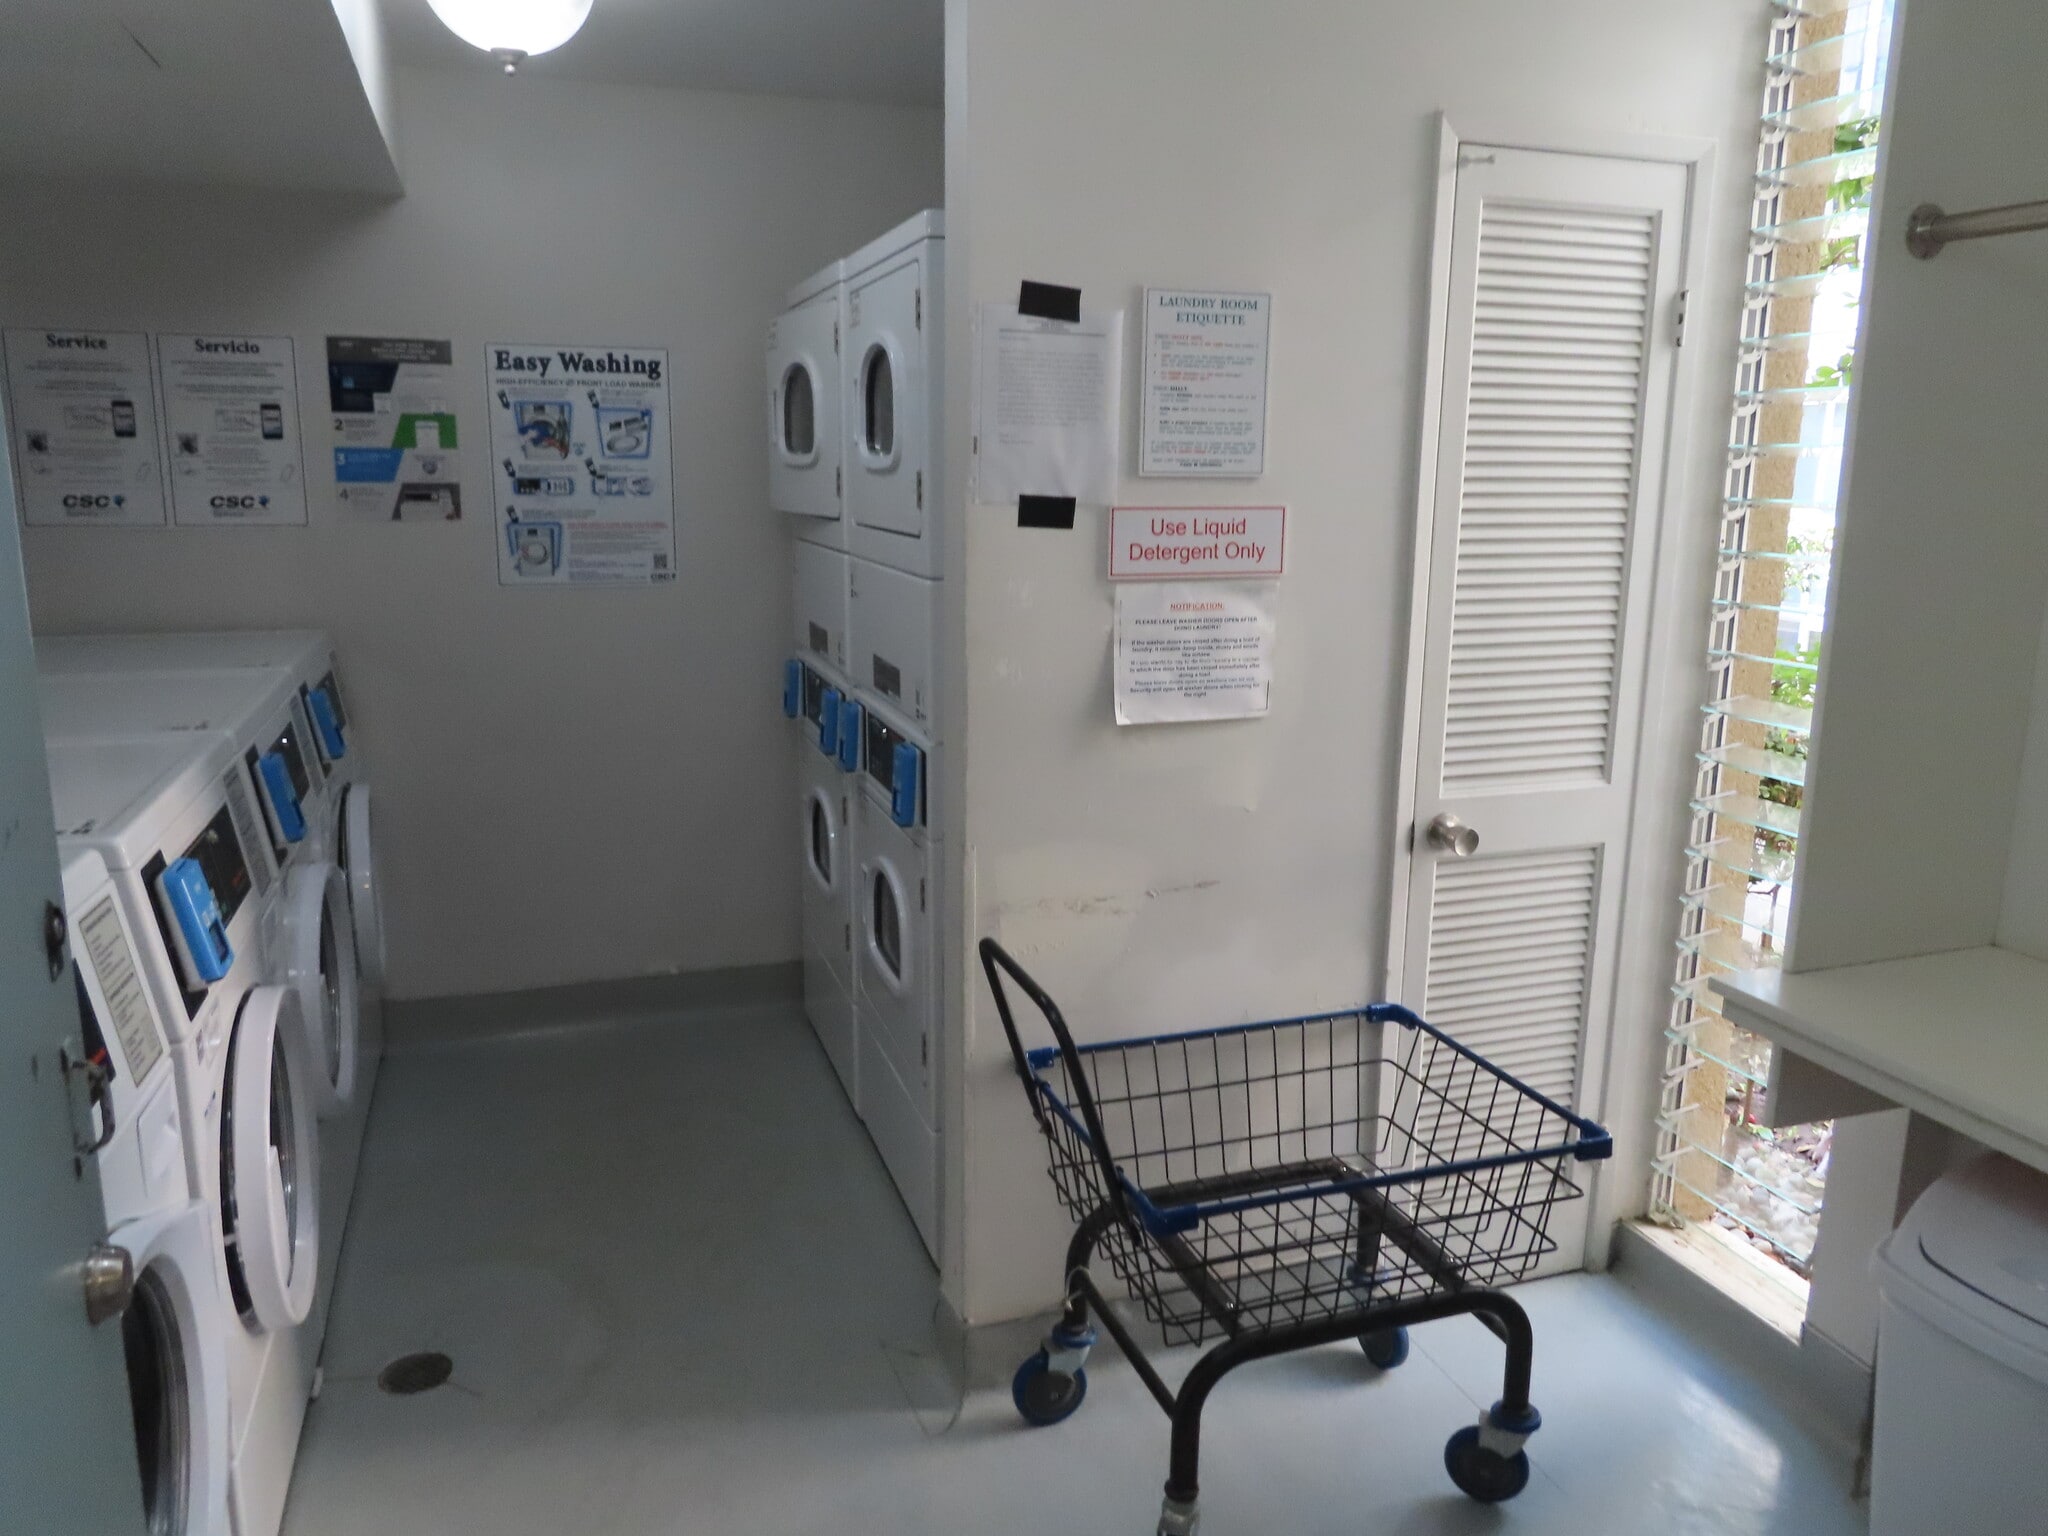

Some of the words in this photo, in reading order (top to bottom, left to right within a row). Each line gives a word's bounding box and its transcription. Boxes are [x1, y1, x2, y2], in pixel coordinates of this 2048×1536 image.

[1160, 296, 1216, 308] LAUNDRY
[1221, 300, 1258, 310] ROOM
[1176, 312, 1246, 326] ETIQUETTE
[46, 333, 108, 349] Service
[195, 338, 260, 354] Servicio
[494, 350, 552, 378] Easy
[557, 352, 661, 380] Washing
[63, 494, 110, 508] CSC
[210, 495, 255, 508] CSC
[1151, 518, 1187, 536] Use
[1194, 518, 1246, 539] Liquid
[1129, 542, 1219, 564] Detergent
[1225, 542, 1266, 564] Only
